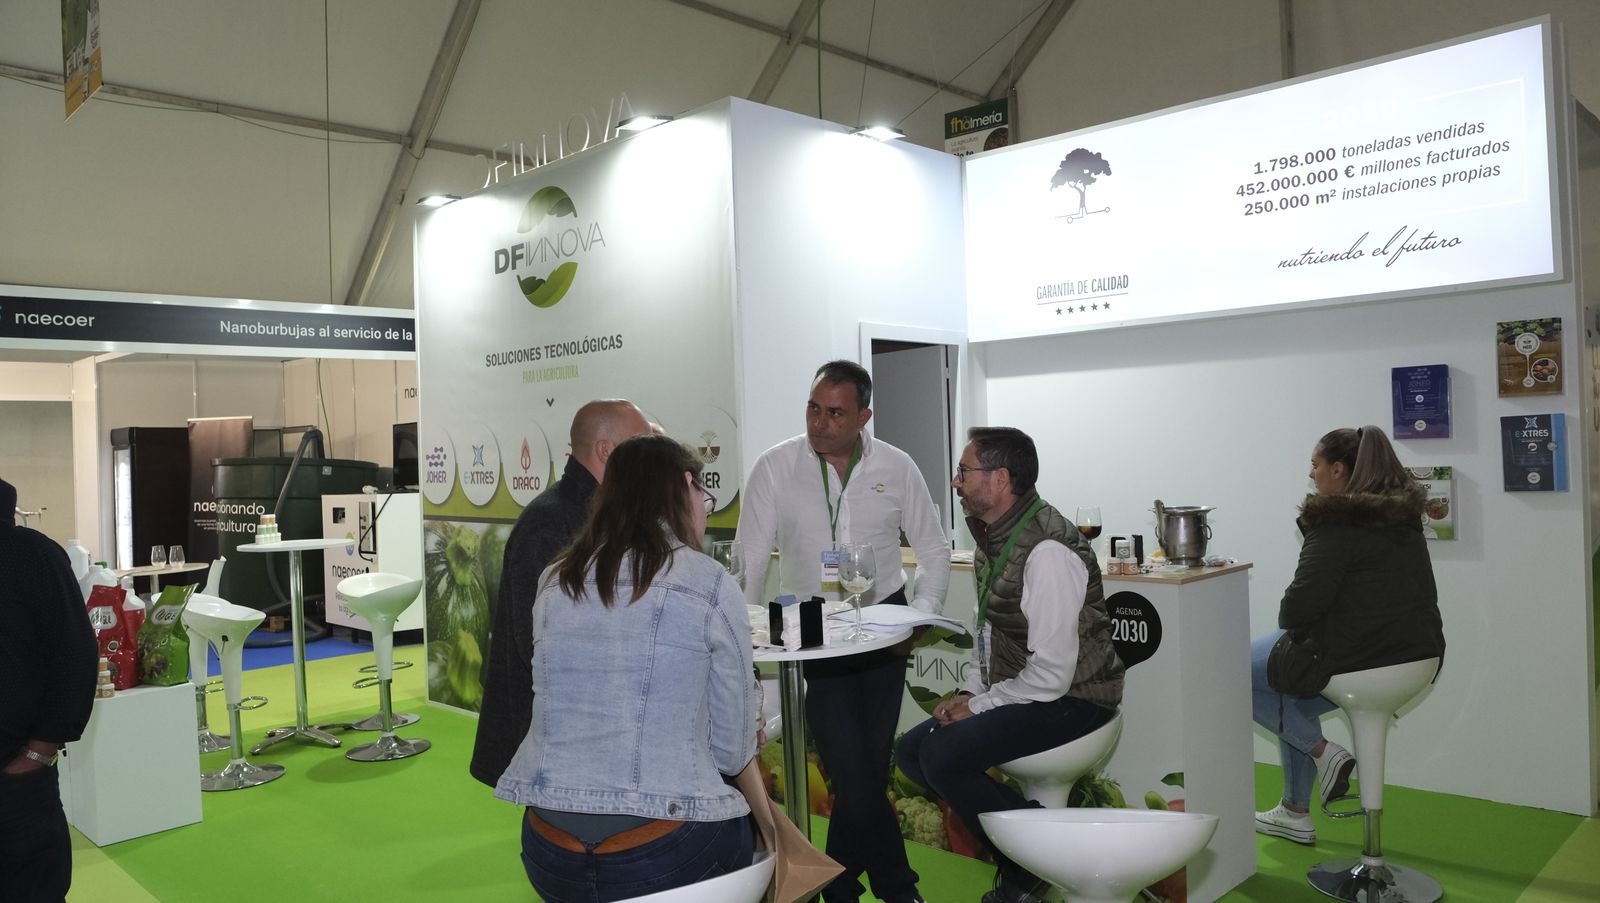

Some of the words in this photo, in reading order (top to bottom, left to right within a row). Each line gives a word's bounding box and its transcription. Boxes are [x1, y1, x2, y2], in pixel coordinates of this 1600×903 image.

[1253, 148, 1336, 175] 1.798.000
[1342, 135, 1412, 158] toneladas
[1416, 121, 1485, 145] vendidas
[1236, 168, 1338, 197] 452.000.000
[1344, 165, 1356, 179] €
[1360, 156, 1421, 177] millones
[1426, 139, 1510, 165] facturados
[1244, 194, 1310, 216] 250.000
[1341, 176, 1437, 201] instalaciones
[1441, 163, 1501, 187] propias
[1277, 231, 1369, 269] nutriendo
[1372, 225, 1408, 256] el
[1385, 228, 1462, 268] futuro
[1077, 279, 1089, 295] DE
[1091, 274, 1129, 293] CALIDAD
[15, 313, 95, 327] naecoer
[220, 320, 315, 339] Nanoburbujas
[319, 326, 330, 338] al
[333, 326, 382, 340] servicio
[384, 328, 399, 341] de
[402, 329, 413, 341] la
[486, 346, 542, 367] SOLUCIONES
[544, 334, 623, 359] TECNOLÓGICAS
[512, 476, 540, 490] DRACO
[1115, 607, 1143, 617] AGENDA
[1111, 618, 1148, 644] 2030
